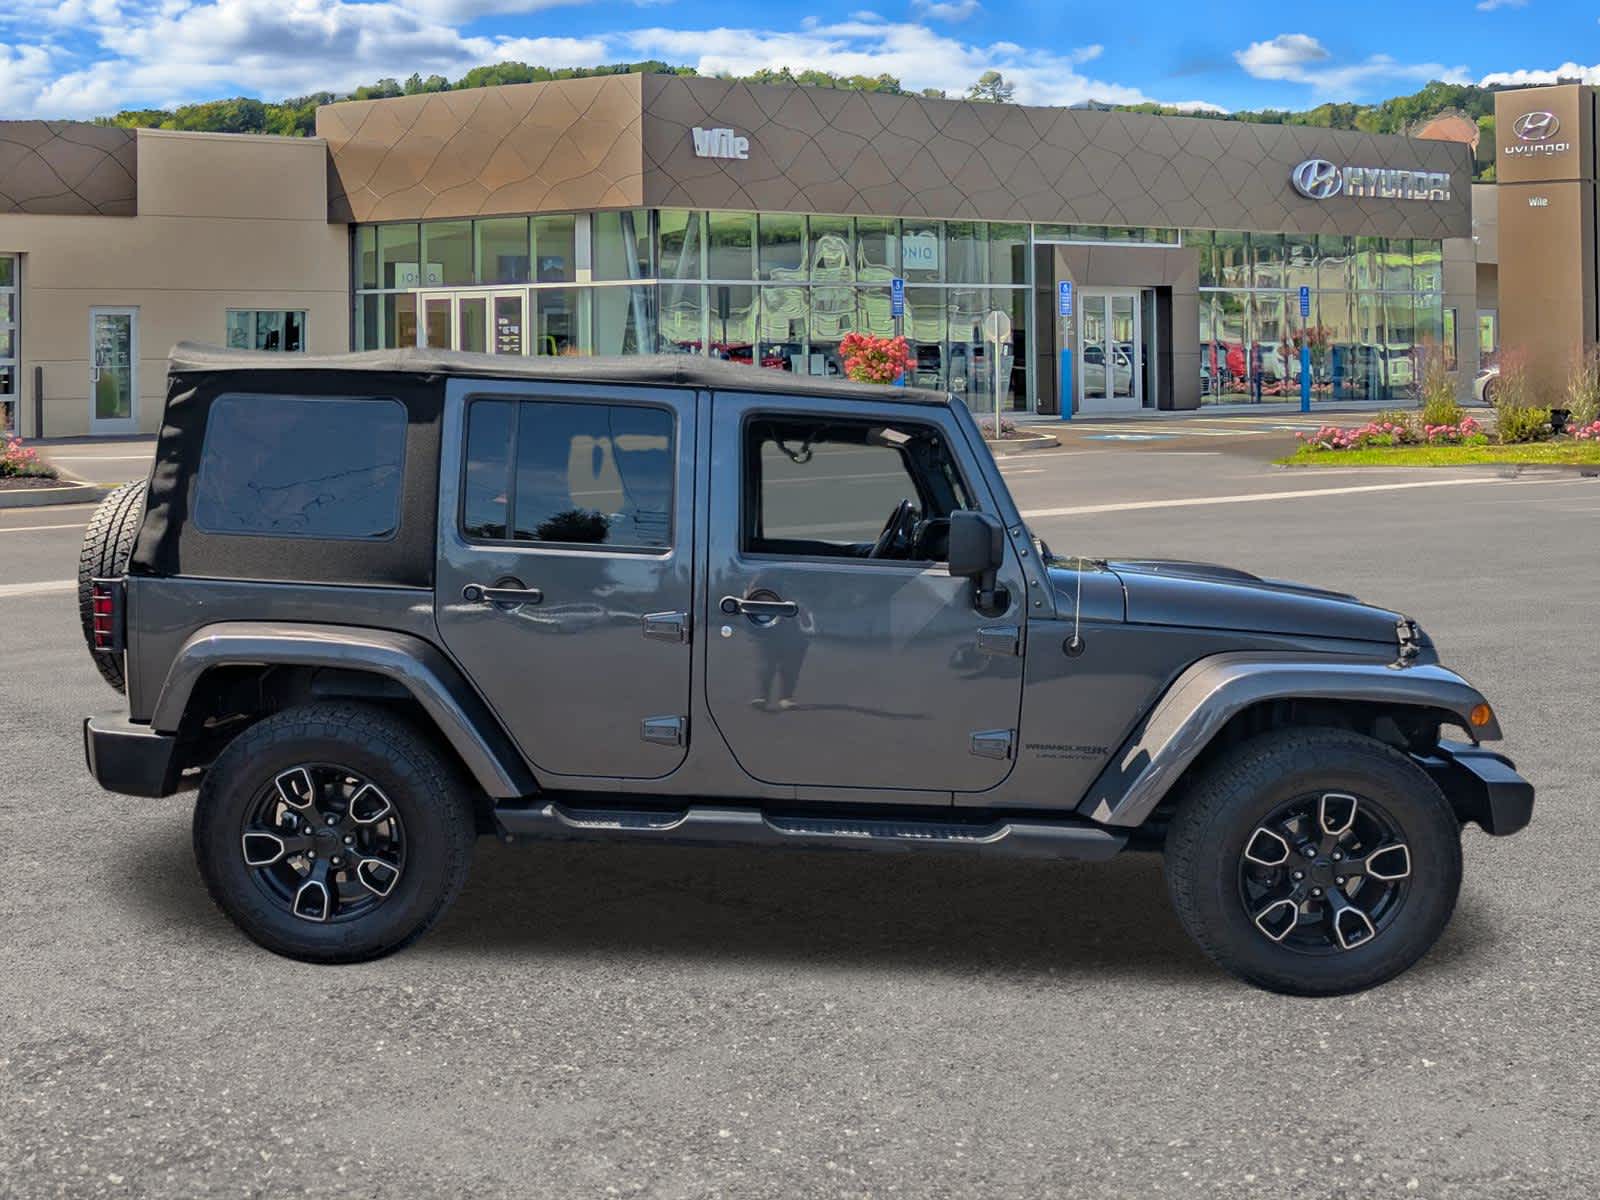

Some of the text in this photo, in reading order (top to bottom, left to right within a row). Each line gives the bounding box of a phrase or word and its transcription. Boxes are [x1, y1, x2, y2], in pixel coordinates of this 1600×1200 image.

[692, 127, 749, 160] Wile
[1342, 166, 1451, 201] HYUNDAI
[1528, 196, 1549, 208] Wile
[903, 247, 932, 259] NIQ
